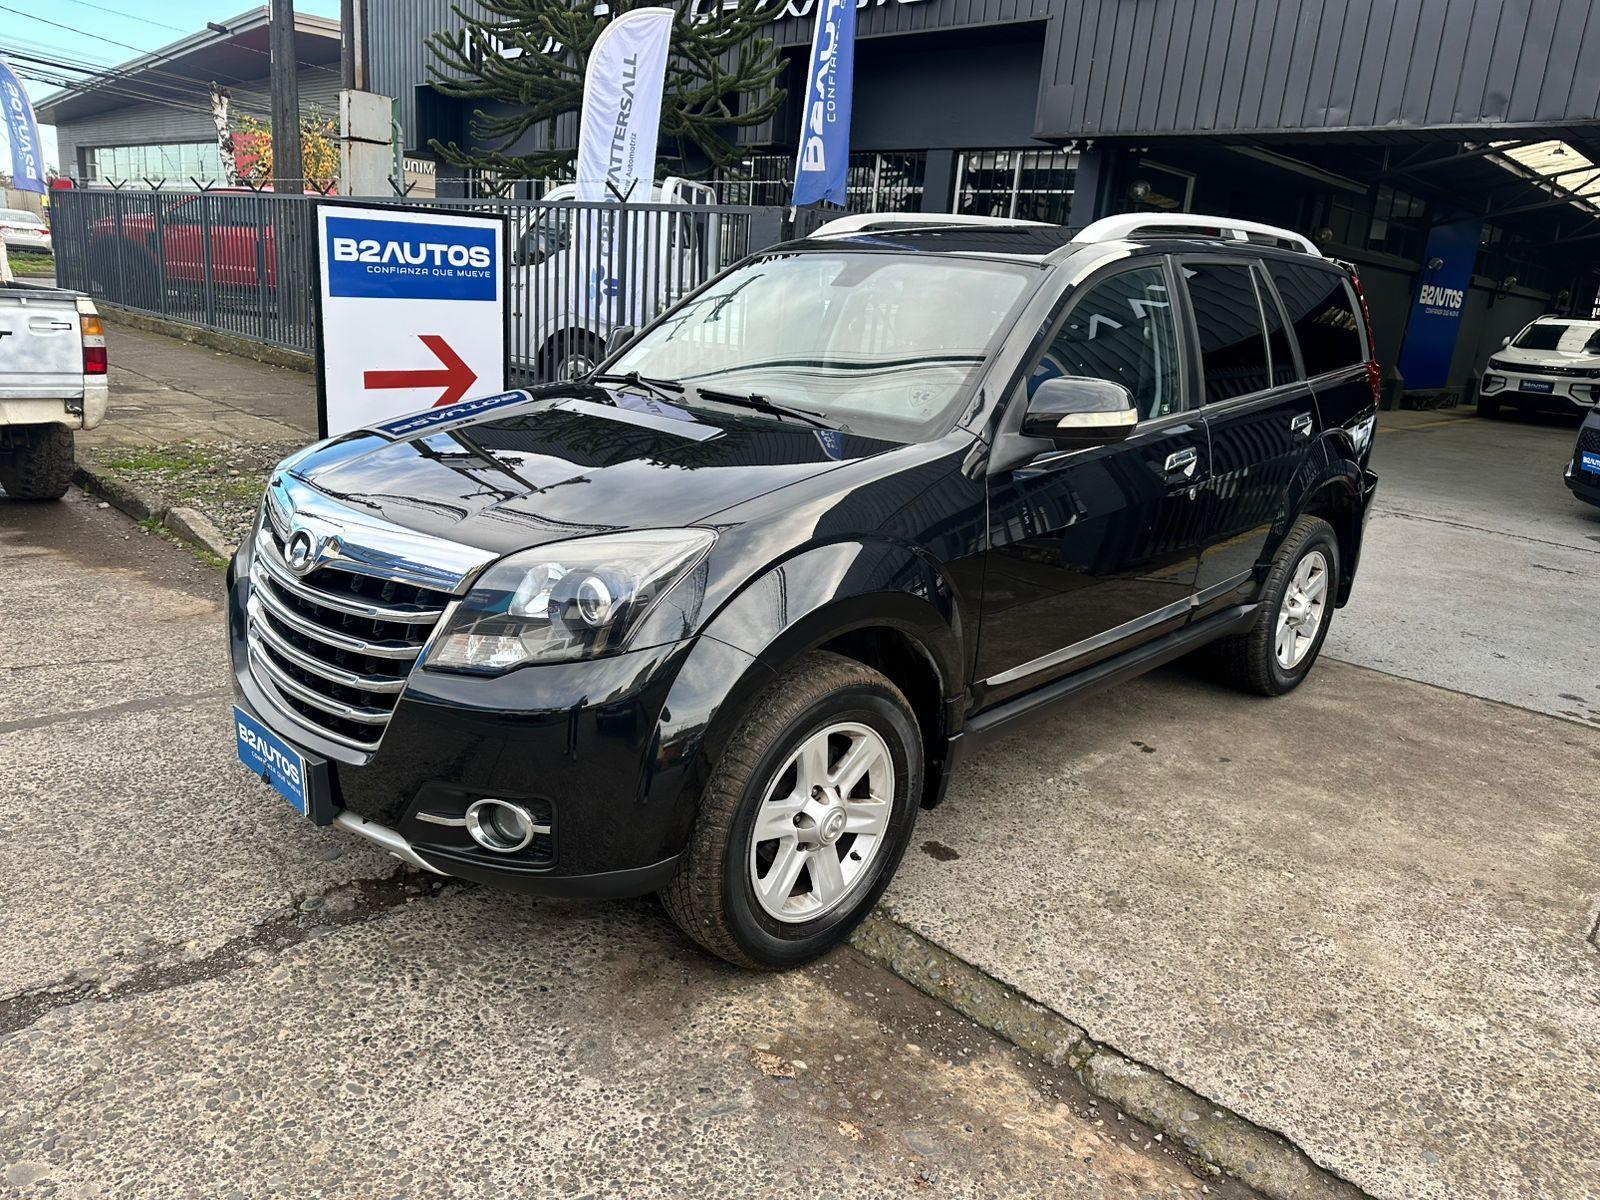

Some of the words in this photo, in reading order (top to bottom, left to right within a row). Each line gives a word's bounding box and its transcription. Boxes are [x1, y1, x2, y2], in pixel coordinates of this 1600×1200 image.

[402, 159, 436, 174] UNIM
[625, 132, 637, 178] Automotriz
[333, 237, 491, 268] B2AUTOS
[366, 265, 429, 276] CONFIANZA
[432, 268, 453, 277] QUE
[456, 269, 491, 278] MUEVE
[1419, 284, 1463, 309] B2AUTOS
[237, 721, 300, 785] B2AUTOS
